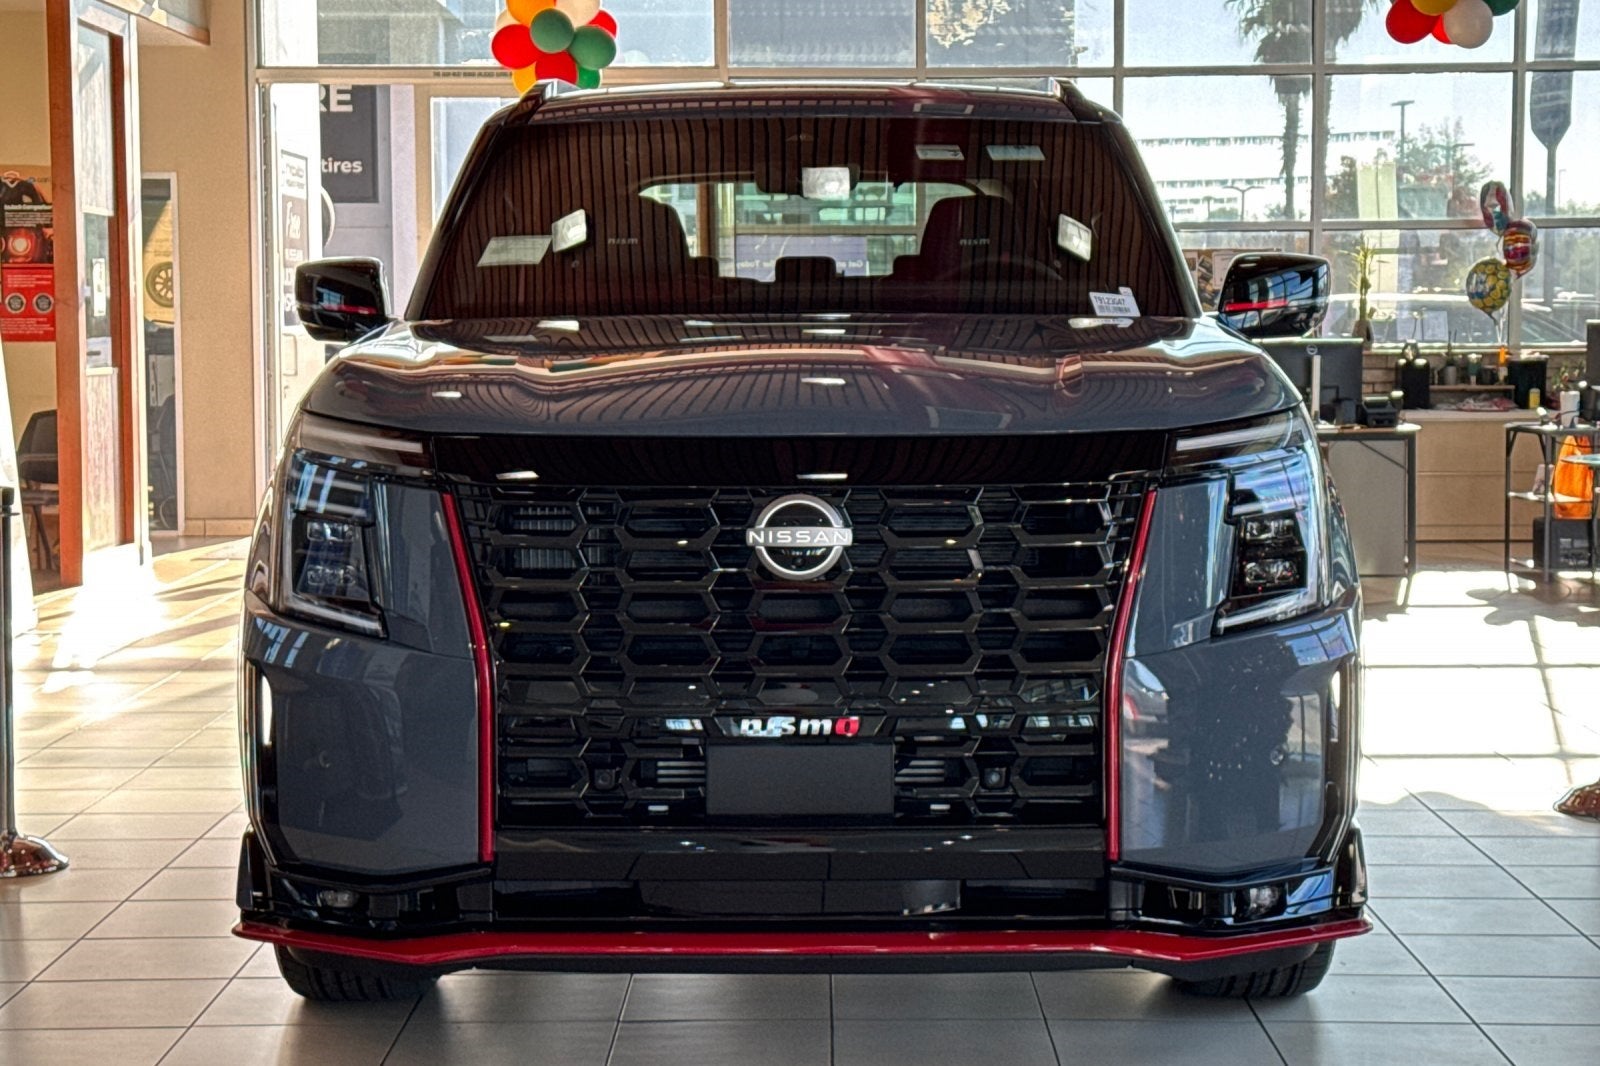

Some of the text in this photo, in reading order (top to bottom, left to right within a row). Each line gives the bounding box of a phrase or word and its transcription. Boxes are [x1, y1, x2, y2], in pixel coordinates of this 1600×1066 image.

[322, 157, 363, 173] tires
[749, 530, 849, 544] NISSAN
[740, 716, 860, 737] nismo
